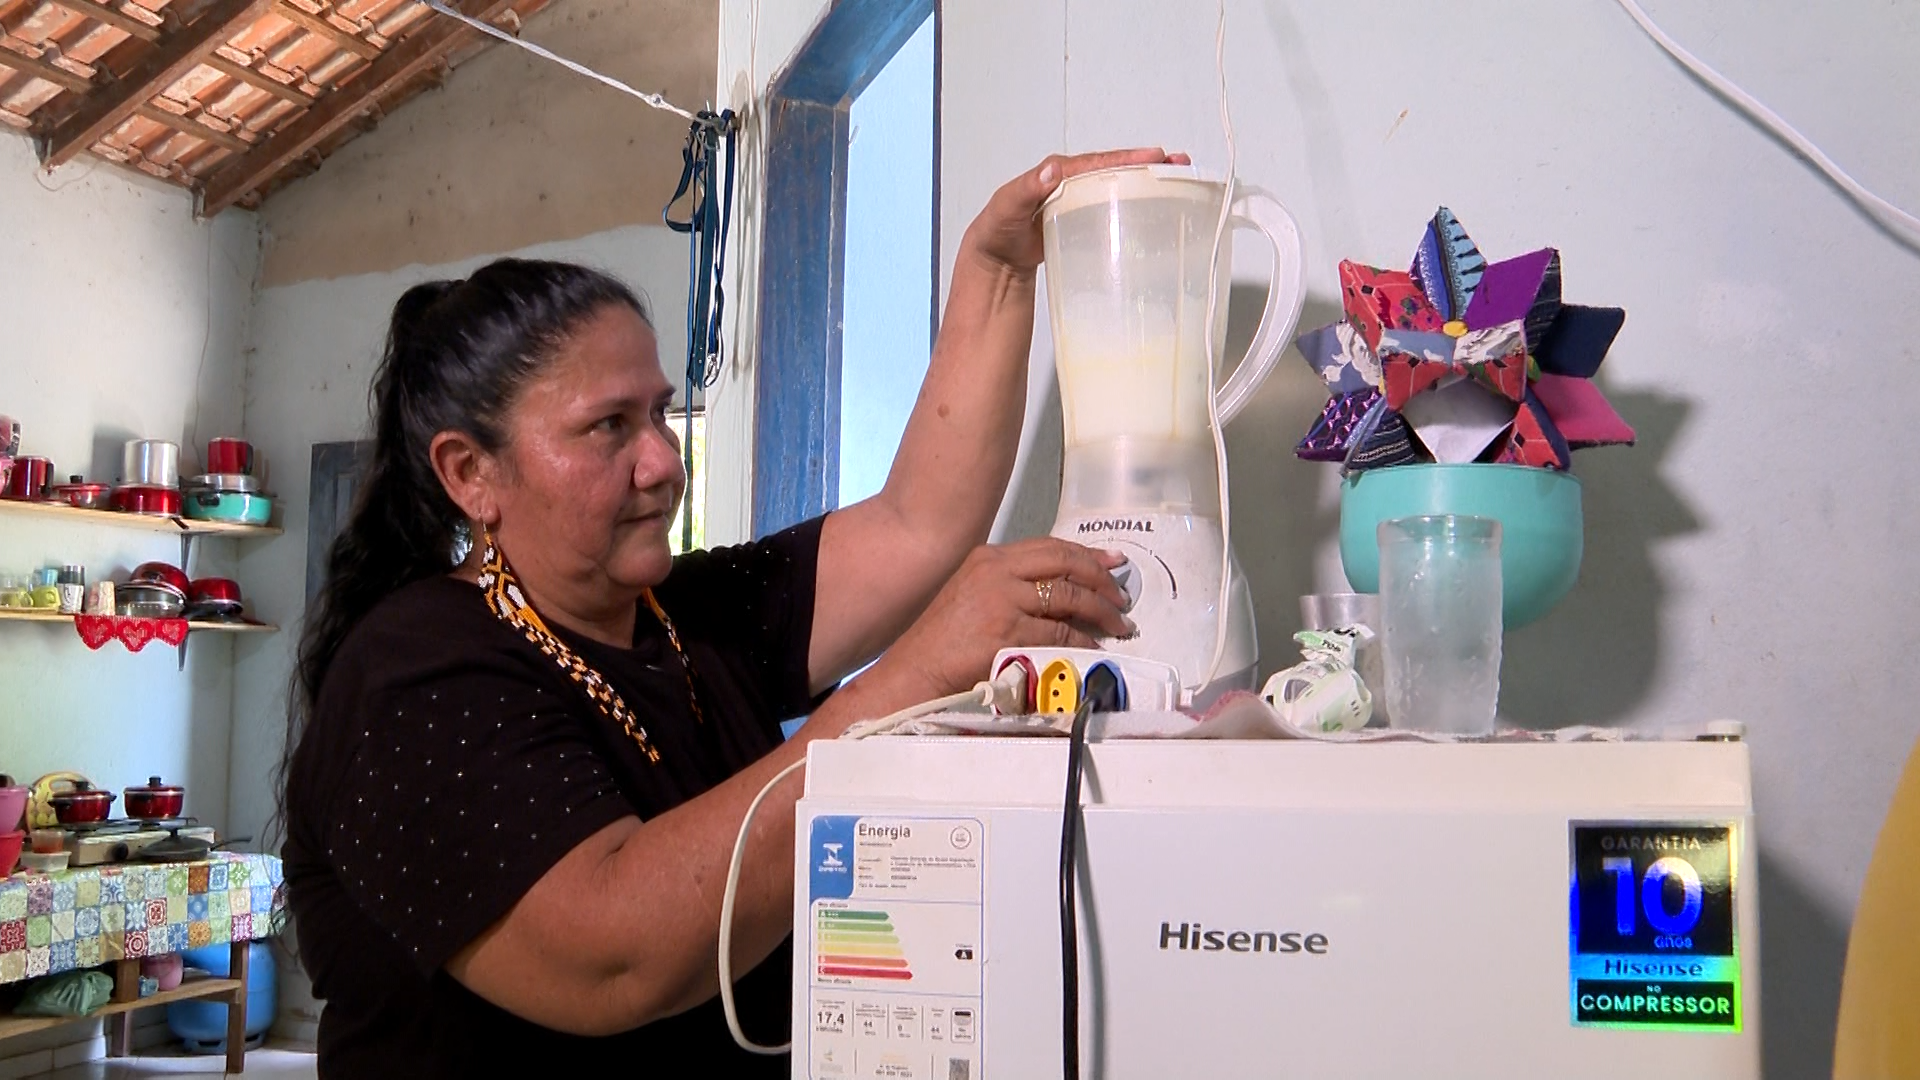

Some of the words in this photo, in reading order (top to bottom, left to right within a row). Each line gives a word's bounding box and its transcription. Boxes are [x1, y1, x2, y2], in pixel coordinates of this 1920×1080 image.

[1077, 519, 1155, 534] MONDIAL
[858, 823, 911, 840] Energia
[1600, 834, 1701, 851] GARANTIA
[1601, 856, 1704, 936] 10
[1159, 922, 1329, 954] Hisense
[1604, 959, 1704, 977] Hisense
[1646, 984, 1662, 994] NO
[1579, 994, 1731, 1015] COMPRESSOR
[816, 1011, 845, 1027] 17,4
